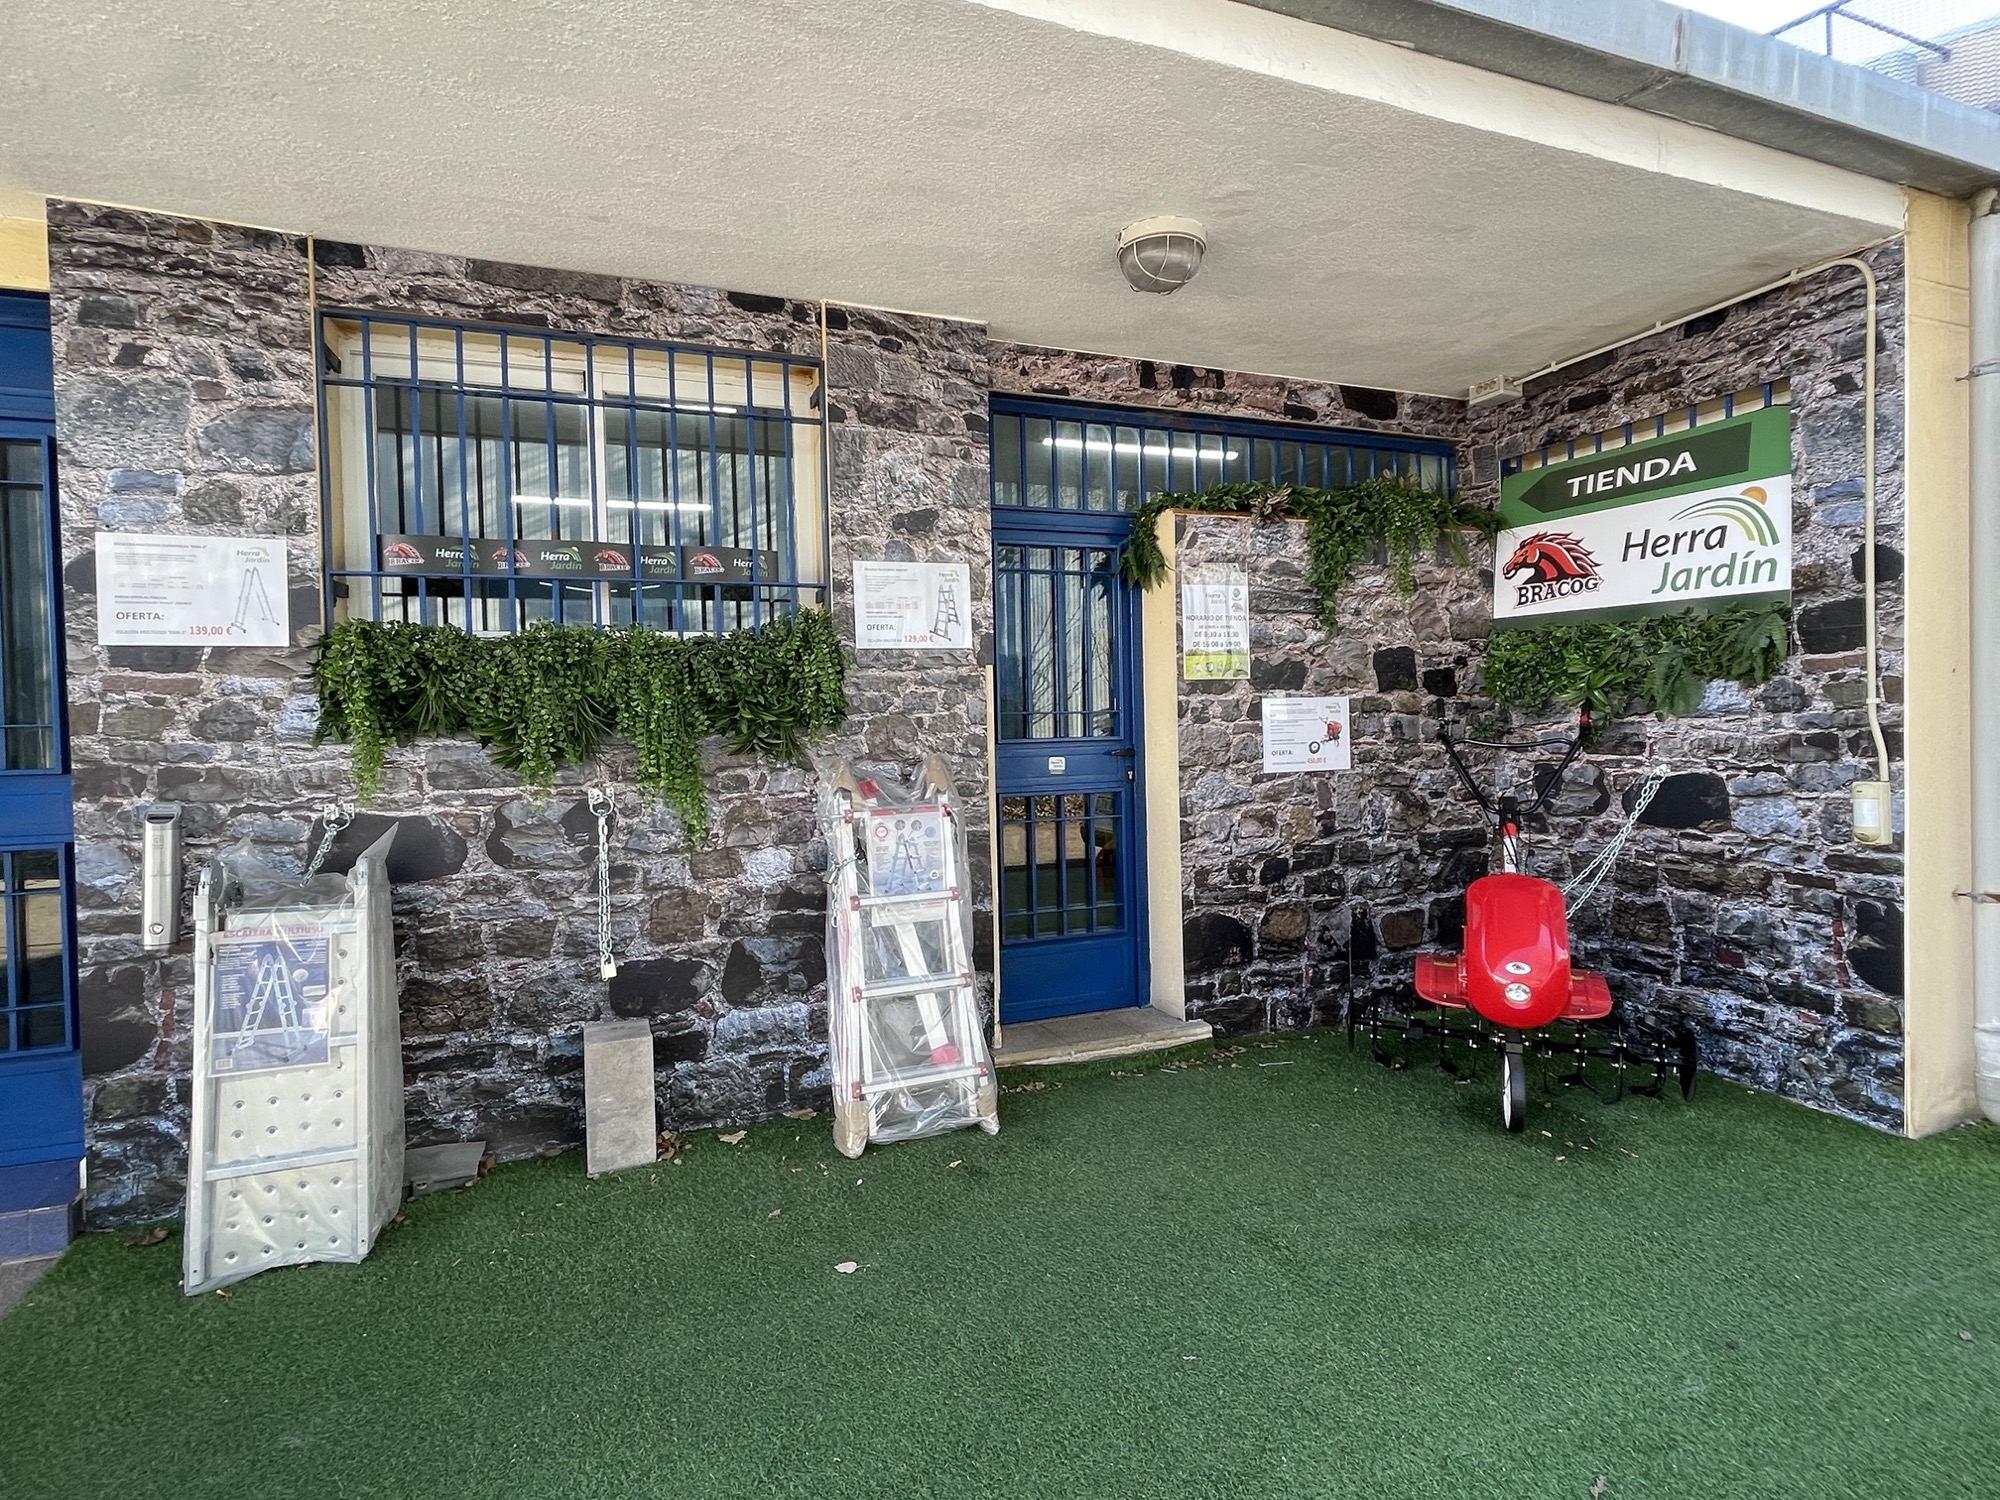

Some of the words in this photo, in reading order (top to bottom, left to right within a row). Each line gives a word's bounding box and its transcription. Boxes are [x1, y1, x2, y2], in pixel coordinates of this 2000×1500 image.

[1567, 451, 1697, 497] TIENDA
[1622, 525, 1728, 562] Herra
[540, 551, 570, 561] Herra
[640, 556, 668, 565] Herra
[445, 560, 480, 568] Jarn
[550, 561, 582, 570] Jardín
[733, 558, 753, 568] Herr
[1651, 551, 1779, 594] Jardín
[1516, 576, 1599, 606] BRACOG
[115, 611, 165, 621] OFERTA:
[1225, 614, 1247, 622] TIENDA
[189, 625, 224, 637] 139,00
[226, 626, 232, 636] €
[904, 634, 928, 643] 129,00
